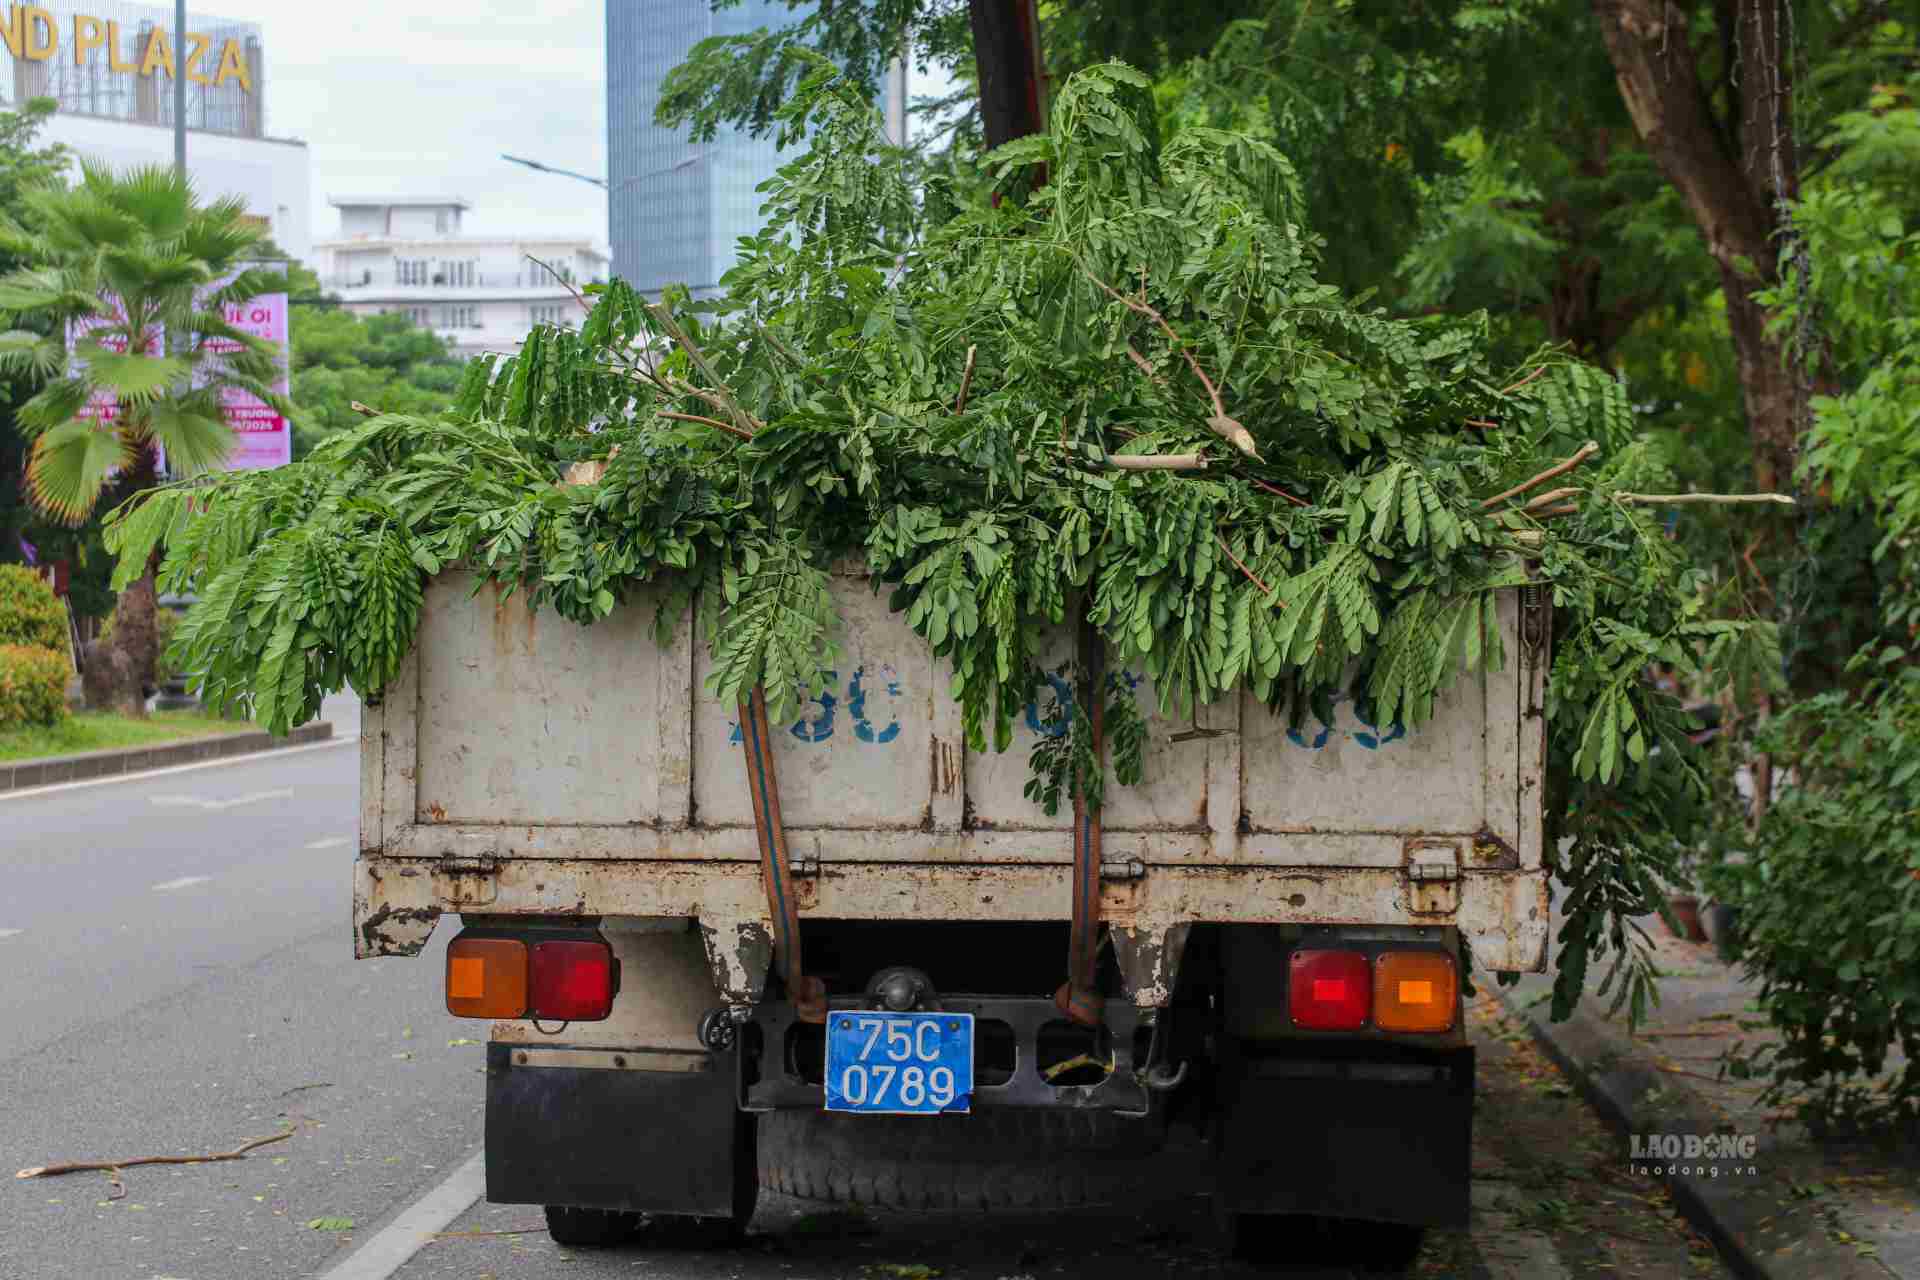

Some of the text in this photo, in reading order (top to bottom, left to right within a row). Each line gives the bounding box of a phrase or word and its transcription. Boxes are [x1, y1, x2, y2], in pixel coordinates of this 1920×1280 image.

[74, 15, 250, 95] PLAZA
[859, 1019, 941, 1062] 75C
[842, 1064, 955, 1107] 0789
